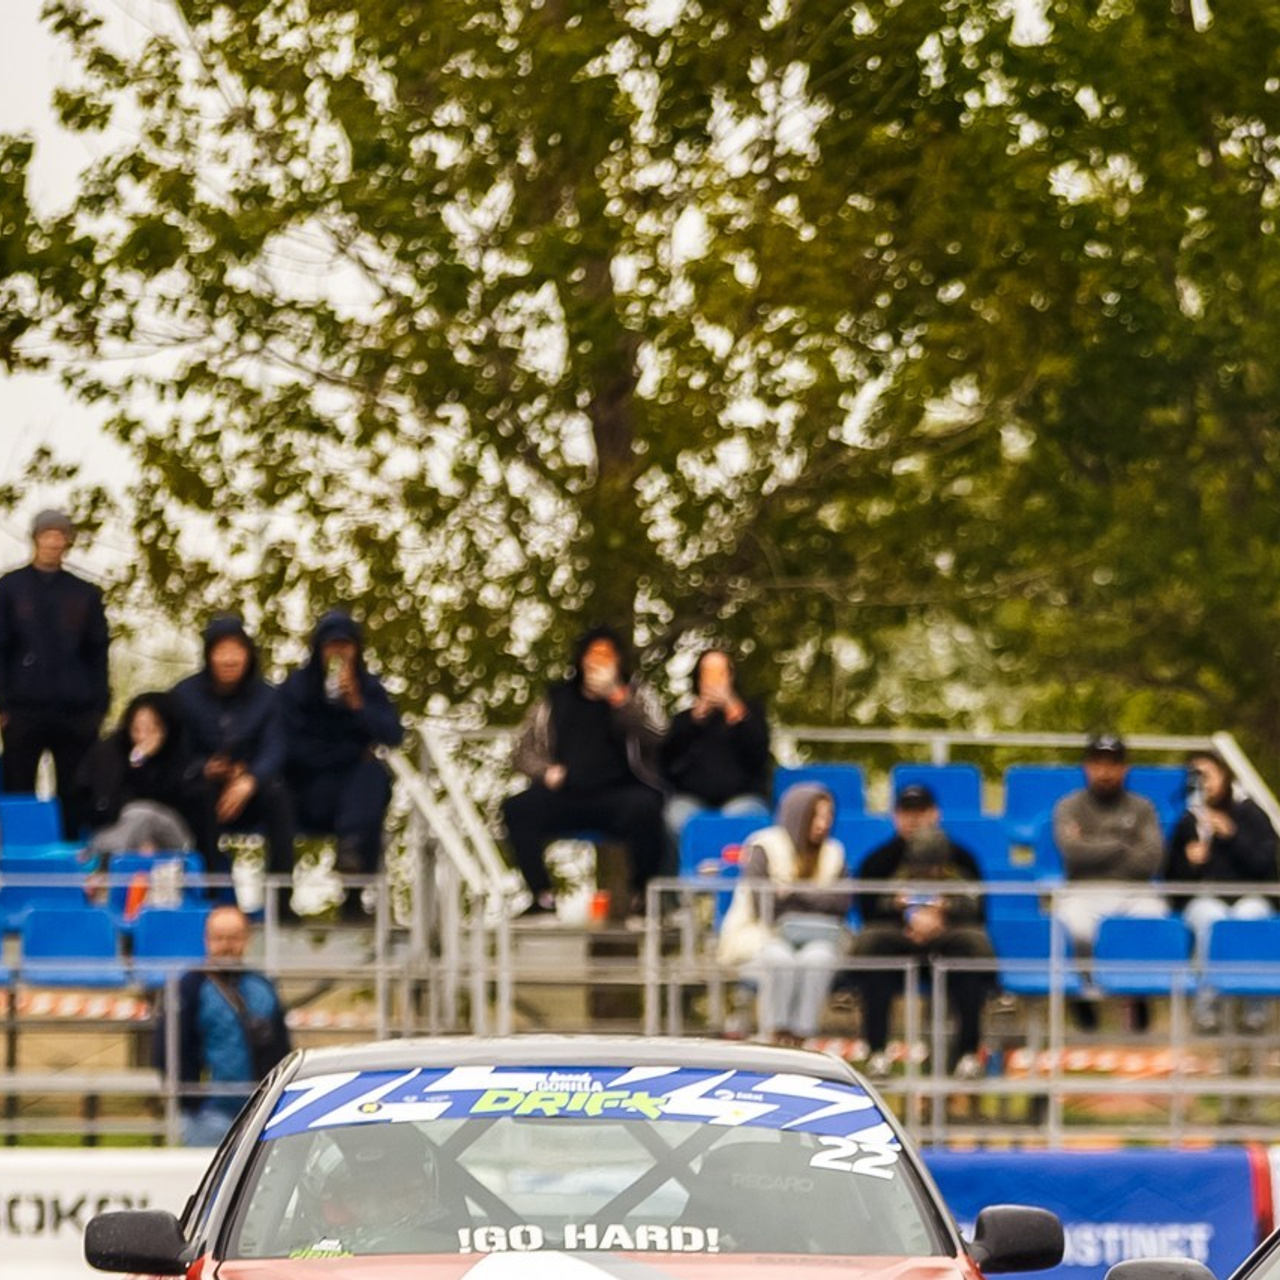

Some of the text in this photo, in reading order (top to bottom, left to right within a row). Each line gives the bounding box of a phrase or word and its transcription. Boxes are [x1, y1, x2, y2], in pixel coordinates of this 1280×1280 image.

[537, 1081, 604, 1092] GORILLA
[810, 1136, 902, 1180] 22
[732, 1172, 814, 1193] RECARO
[458, 1223, 720, 1254] !GO HARD!
